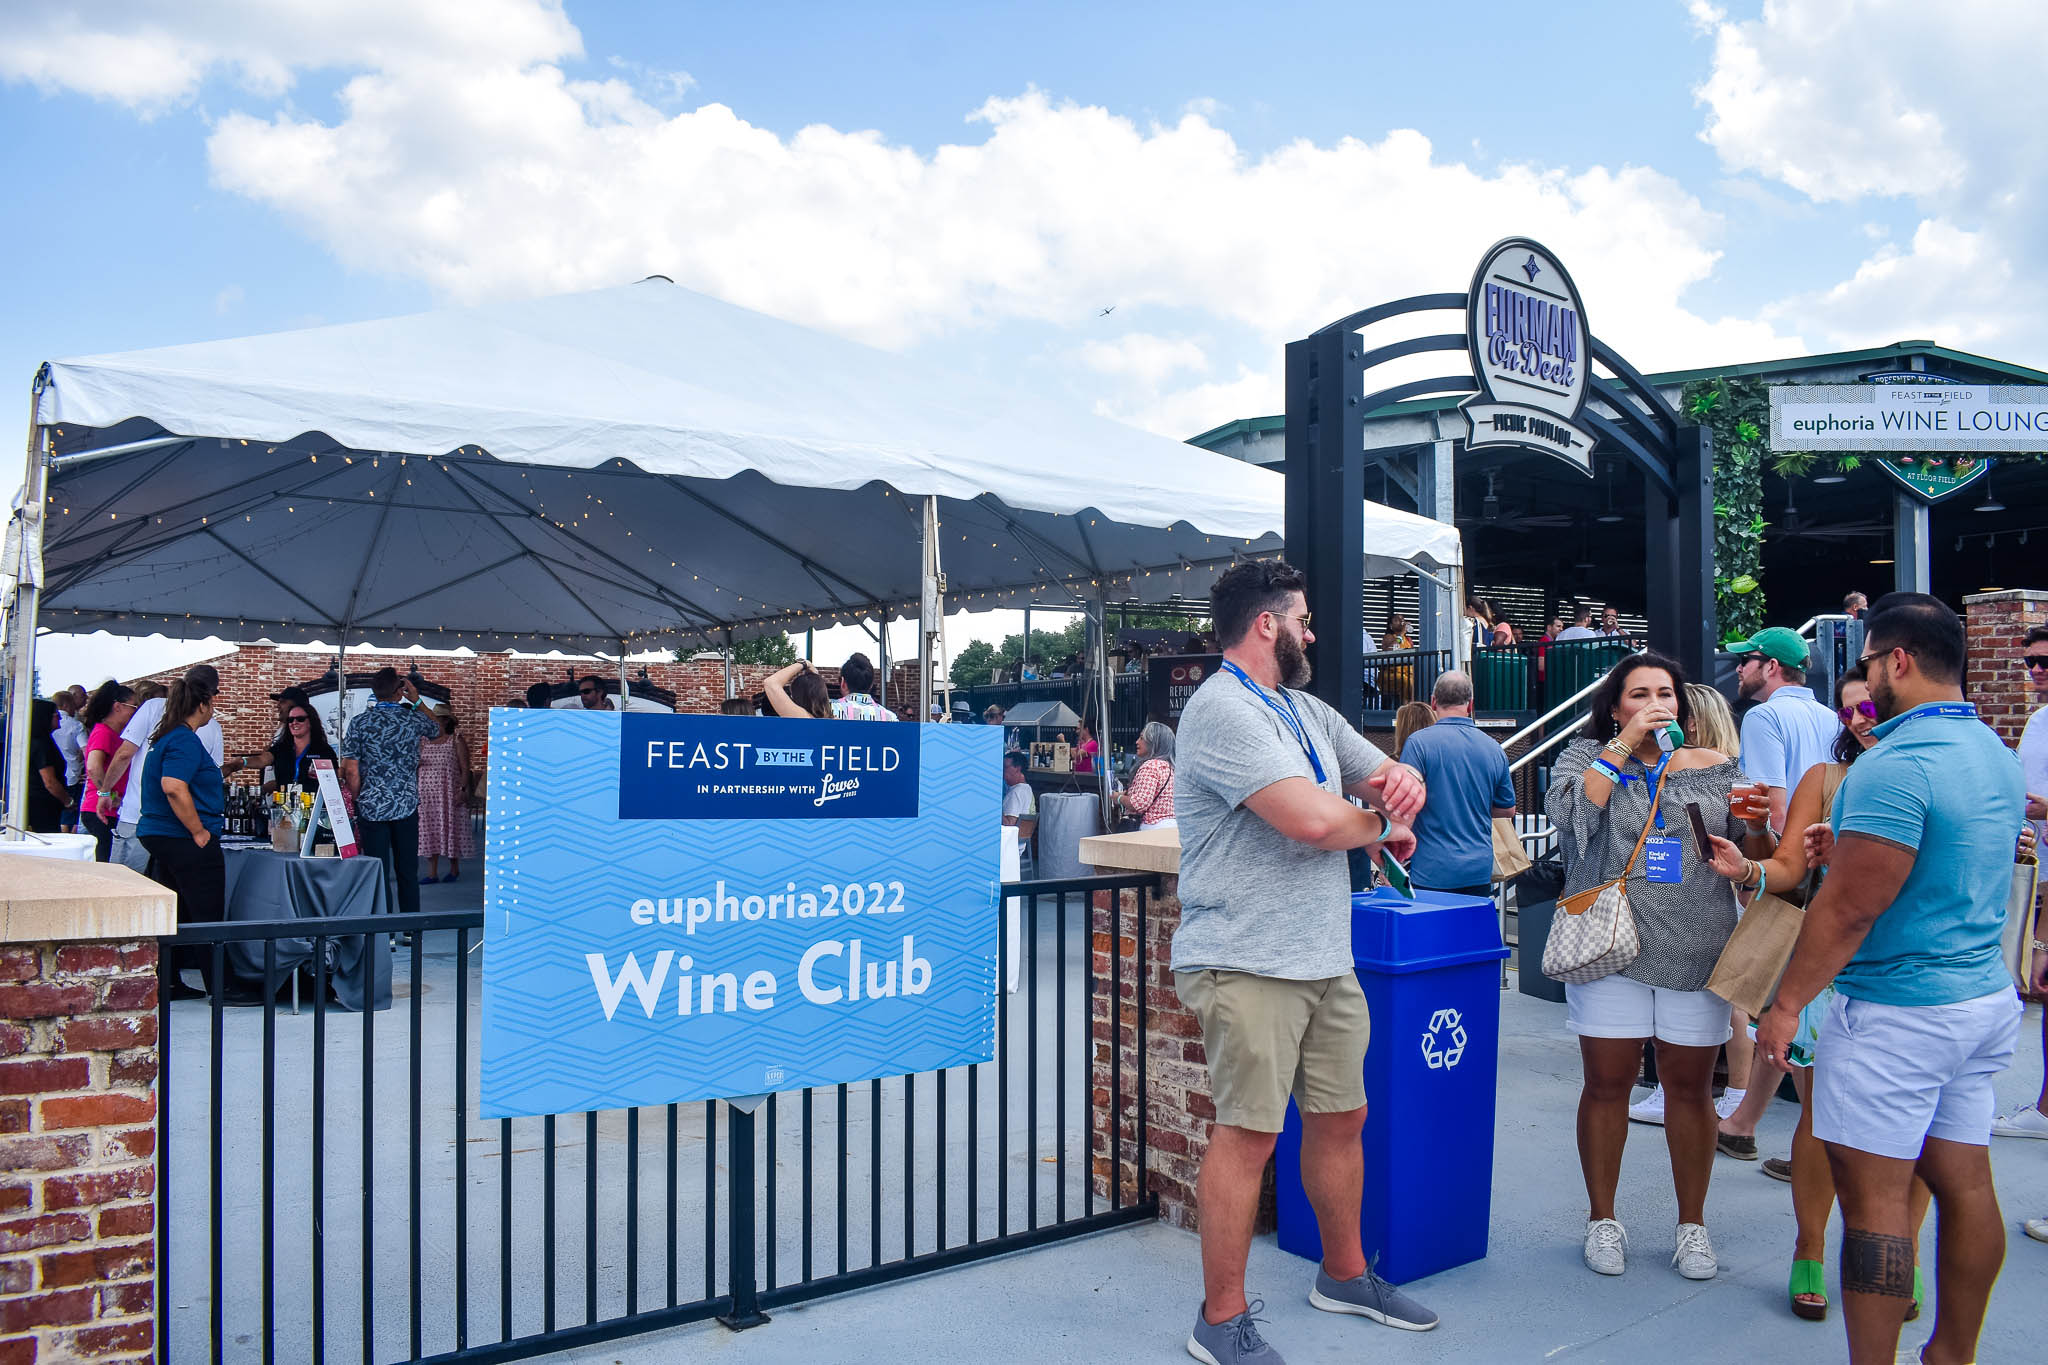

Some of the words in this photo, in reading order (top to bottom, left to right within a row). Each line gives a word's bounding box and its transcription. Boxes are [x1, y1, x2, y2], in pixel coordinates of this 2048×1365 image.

[1485, 282, 1577, 362] FURMAN
[1488, 329, 1520, 371] On
[1520, 340, 1576, 387] Deck
[1891, 391, 1922, 400] FEAST
[1944, 391, 1973, 400] FIELD
[1493, 413, 1527, 433] PICNIC
[1529, 417, 1572, 448] PAVILION
[1793, 413, 1875, 435] euphoria
[1881, 411, 1948, 430] WINE
[1958, 411, 2048, 432] LOUNG
[1169, 685, 1200, 697] REPUB
[1169, 697, 1189, 709] NATI
[647, 741, 752, 770] FEAST
[763, 752, 779, 763] BY
[782, 752, 806, 763] THE
[821, 745, 900, 772] FIELD
[697, 785, 709, 793] IN
[713, 785, 786, 795] PARTNERSHIP
[788, 785, 816, 794] WITH
[813, 773, 860, 807] Lowes
[1645, 837, 1665, 845] 2022
[629, 880, 906, 936] euphoria2022
[585, 949, 778, 1022] Wine
[797, 935, 933, 1006] Club
